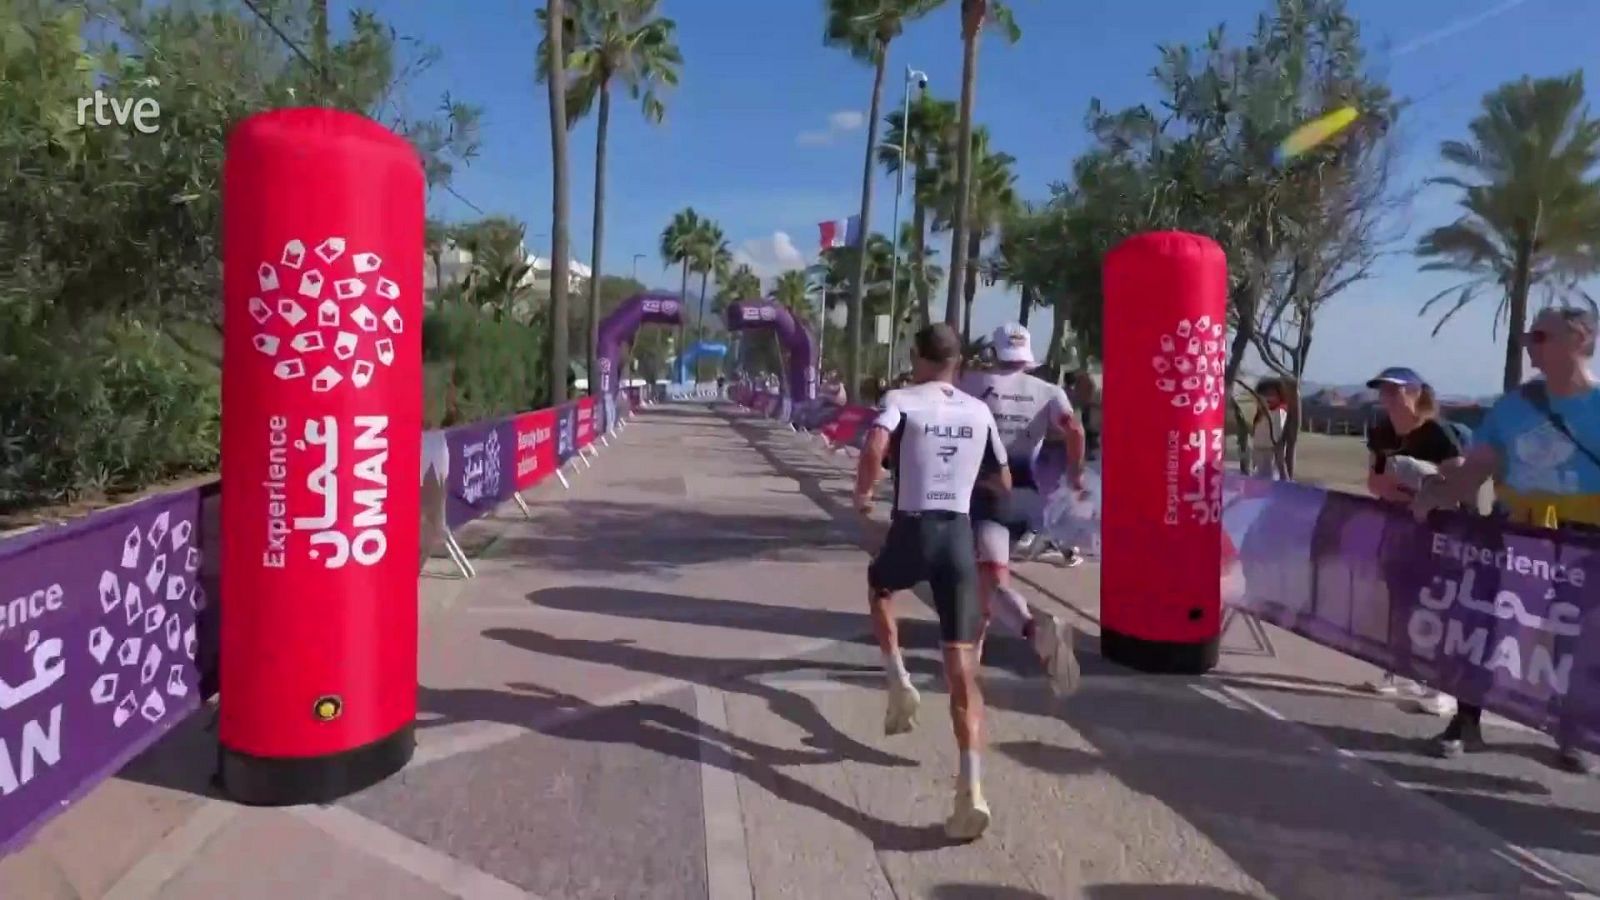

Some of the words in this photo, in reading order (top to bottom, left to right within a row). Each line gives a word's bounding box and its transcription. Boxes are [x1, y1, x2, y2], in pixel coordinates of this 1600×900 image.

[924, 423, 973, 439] HUUB
[262, 415, 291, 568] Experience
[352, 415, 389, 566] OMAN
[1432, 532, 1586, 588] Experience
[1407, 608, 1574, 695] OMAN
